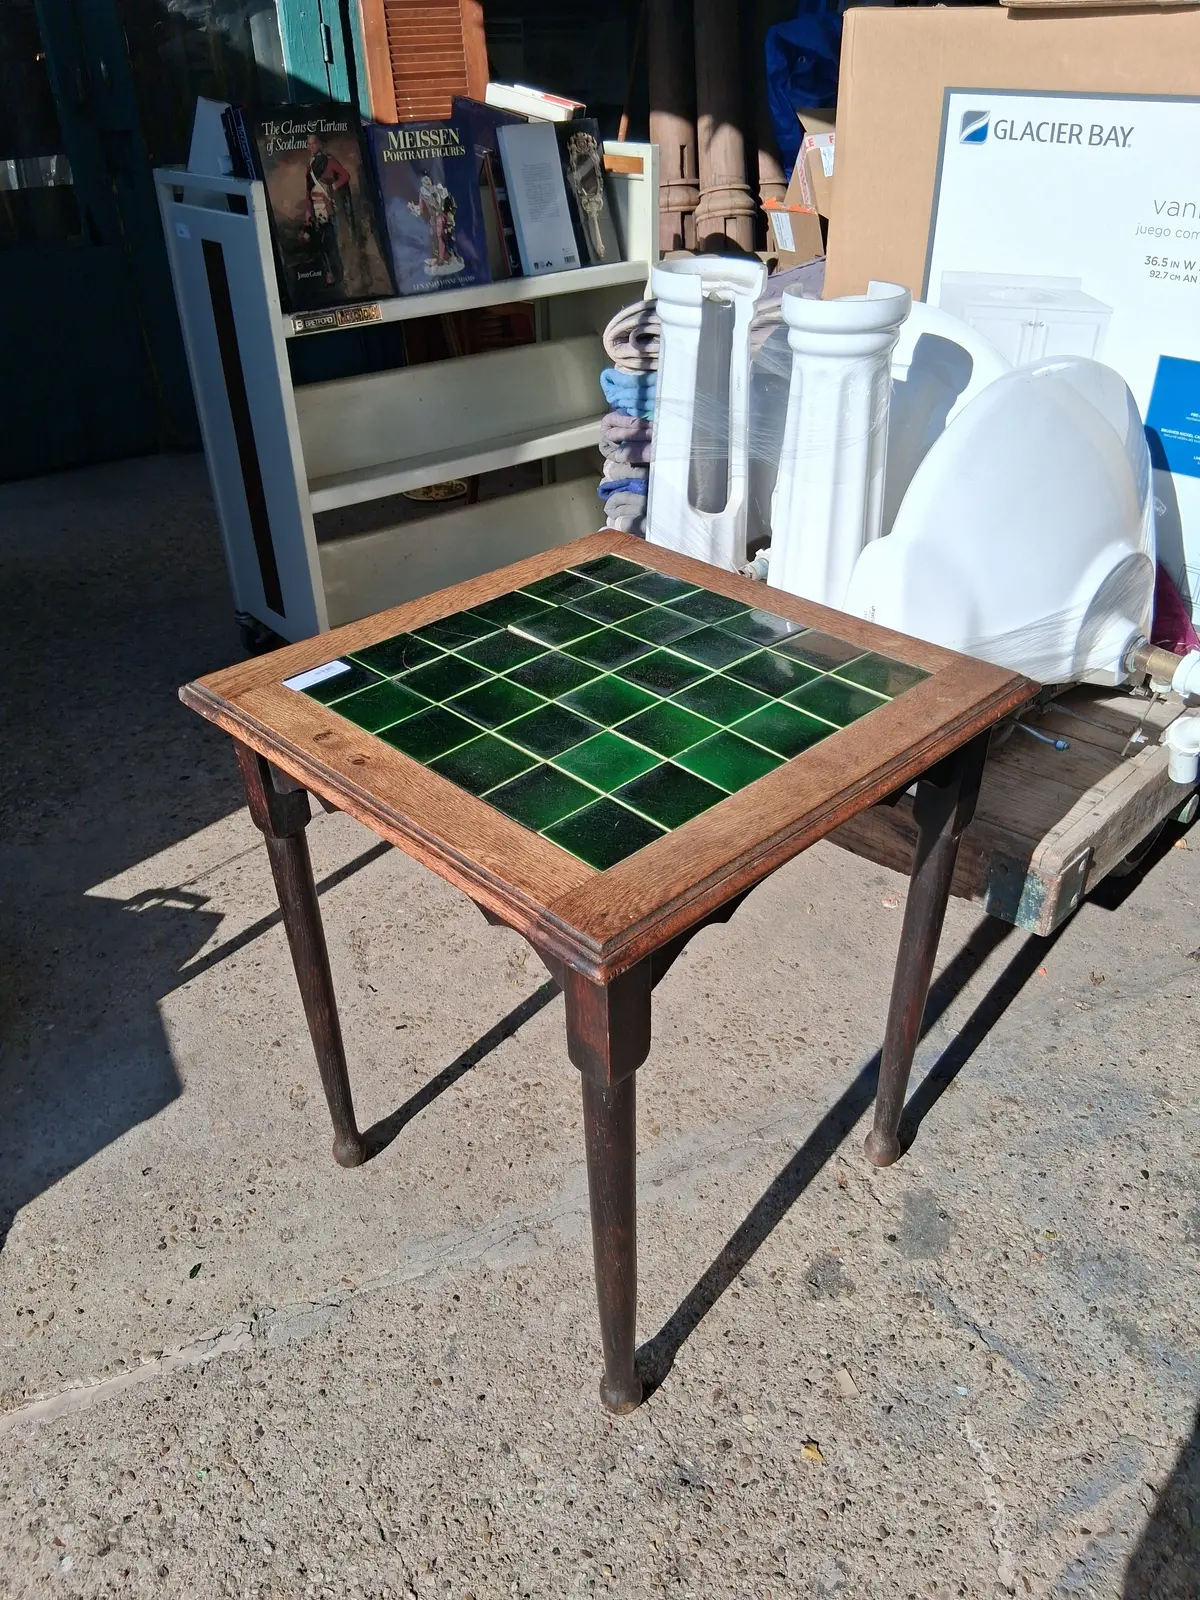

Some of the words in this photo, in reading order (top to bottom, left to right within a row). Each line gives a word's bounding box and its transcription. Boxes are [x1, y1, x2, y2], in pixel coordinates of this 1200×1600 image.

[261, 121, 280, 136] The
[281, 120, 307, 134] Clans
[307, 120, 318, 133] &
[317, 119, 348, 132] Tartans
[993, 119, 1083, 145] GLACIER
[1088, 124, 1135, 148] BAY
[266, 137, 276, 156] of
[387, 128, 460, 150] MEISSEN
[383, 149, 429, 162] PORTRAIT
[431, 146, 466, 158] FIGURES
[1135, 222, 1171, 237] juego
[1144, 255, 1168, 267] 36.5
[1170, 260, 1180, 268] IN
[1184, 260, 1196, 270] W
[1149, 270, 1168, 279] 92.7
[1183, 274, 1198, 283] AN
[305, 316, 333, 328] BRETFORD
